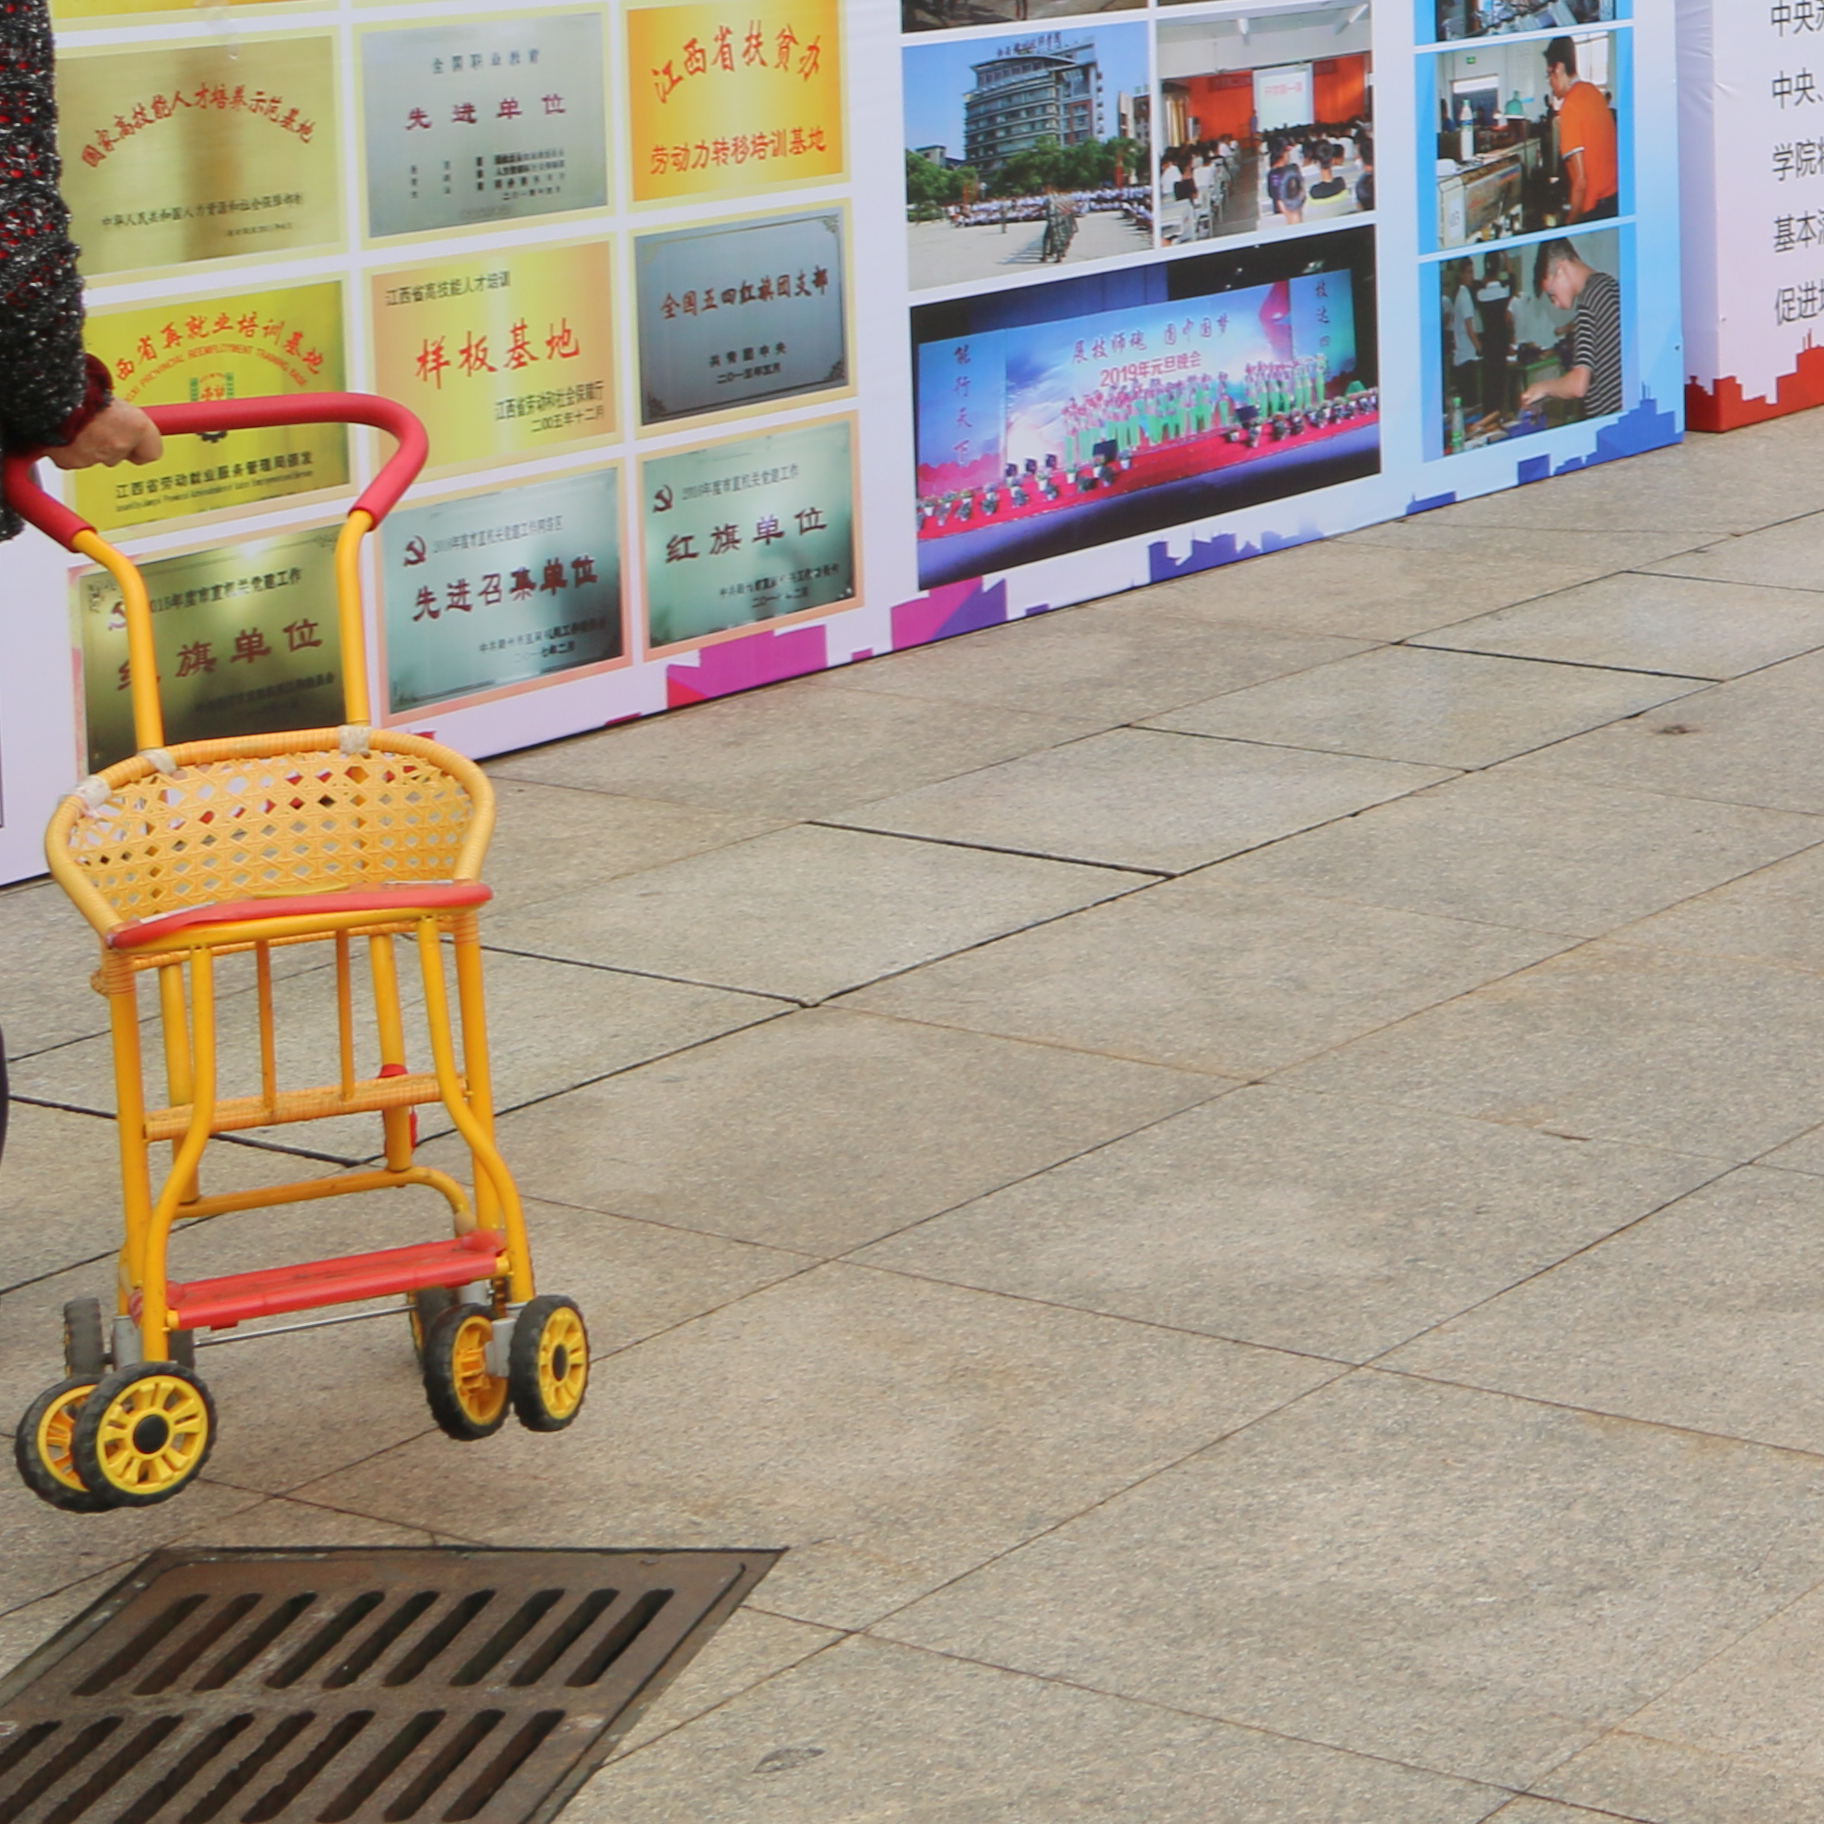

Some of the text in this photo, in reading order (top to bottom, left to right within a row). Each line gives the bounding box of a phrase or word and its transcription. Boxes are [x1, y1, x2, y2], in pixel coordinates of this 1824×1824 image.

[650, 19, 821, 104] 江西省扶贫办
[405, 93, 567, 131] 先进单位
[649, 125, 827, 176] 劳动力转移培训基地
[414, 316, 581, 391] 样板基地
[664, 506, 828, 565] 红旗单位
